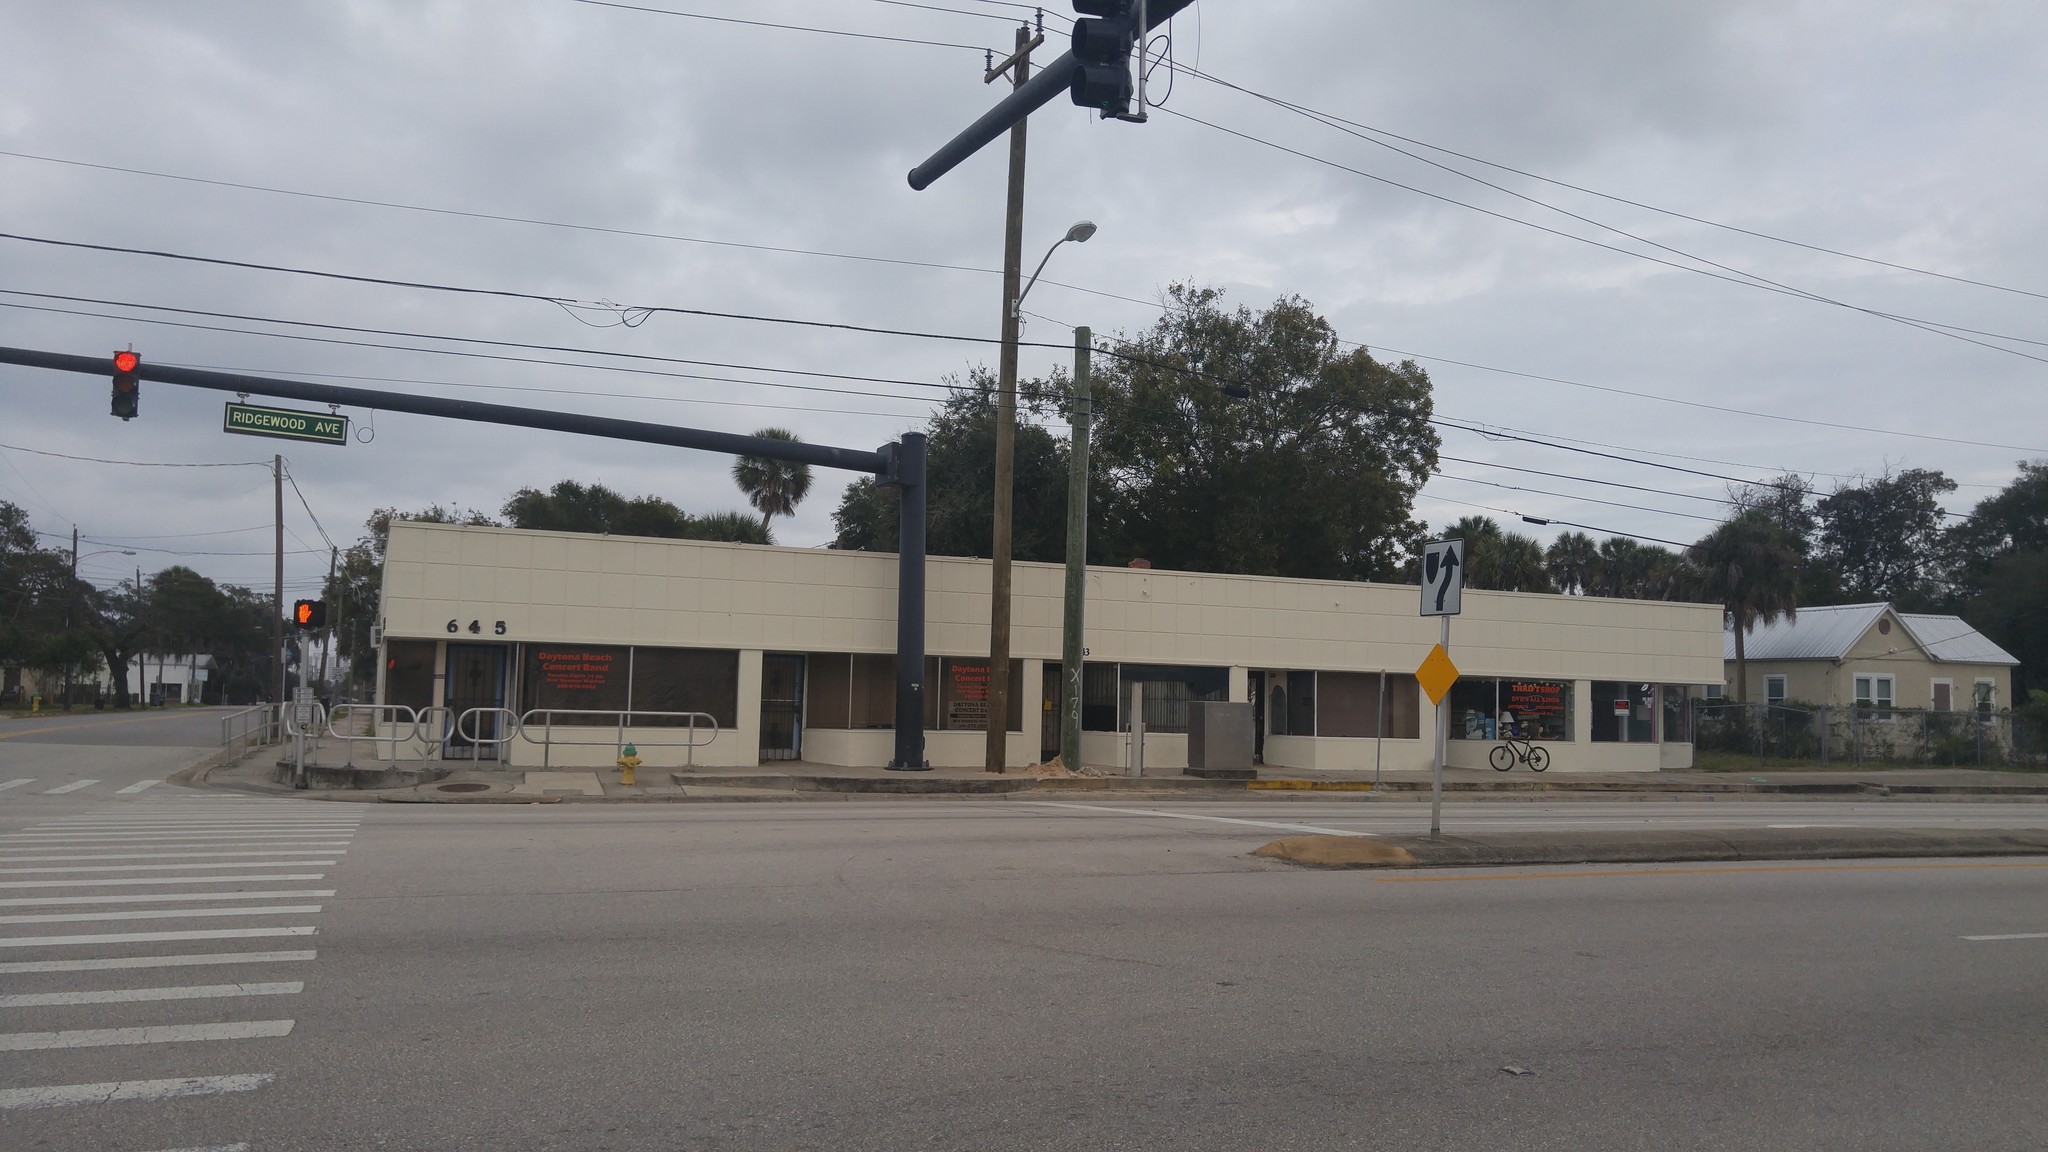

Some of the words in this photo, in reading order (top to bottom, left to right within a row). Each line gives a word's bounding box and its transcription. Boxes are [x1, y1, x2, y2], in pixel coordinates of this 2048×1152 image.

[232, 411, 306, 431] RIDGEWOOD
[314, 421, 340, 435] AVE
[446, 619, 507, 635] 645
[538, 652, 581, 662] Daytona
[582, 653, 613, 662] Beach
[542, 662, 581, 671] Concert
[583, 663, 609, 672] Band
[951, 665, 985, 674] Daytona
[954, 674, 986, 682] Concert
[1511, 684, 1541, 693] THRIFT
[1541, 685, 1561, 694] SHOP
